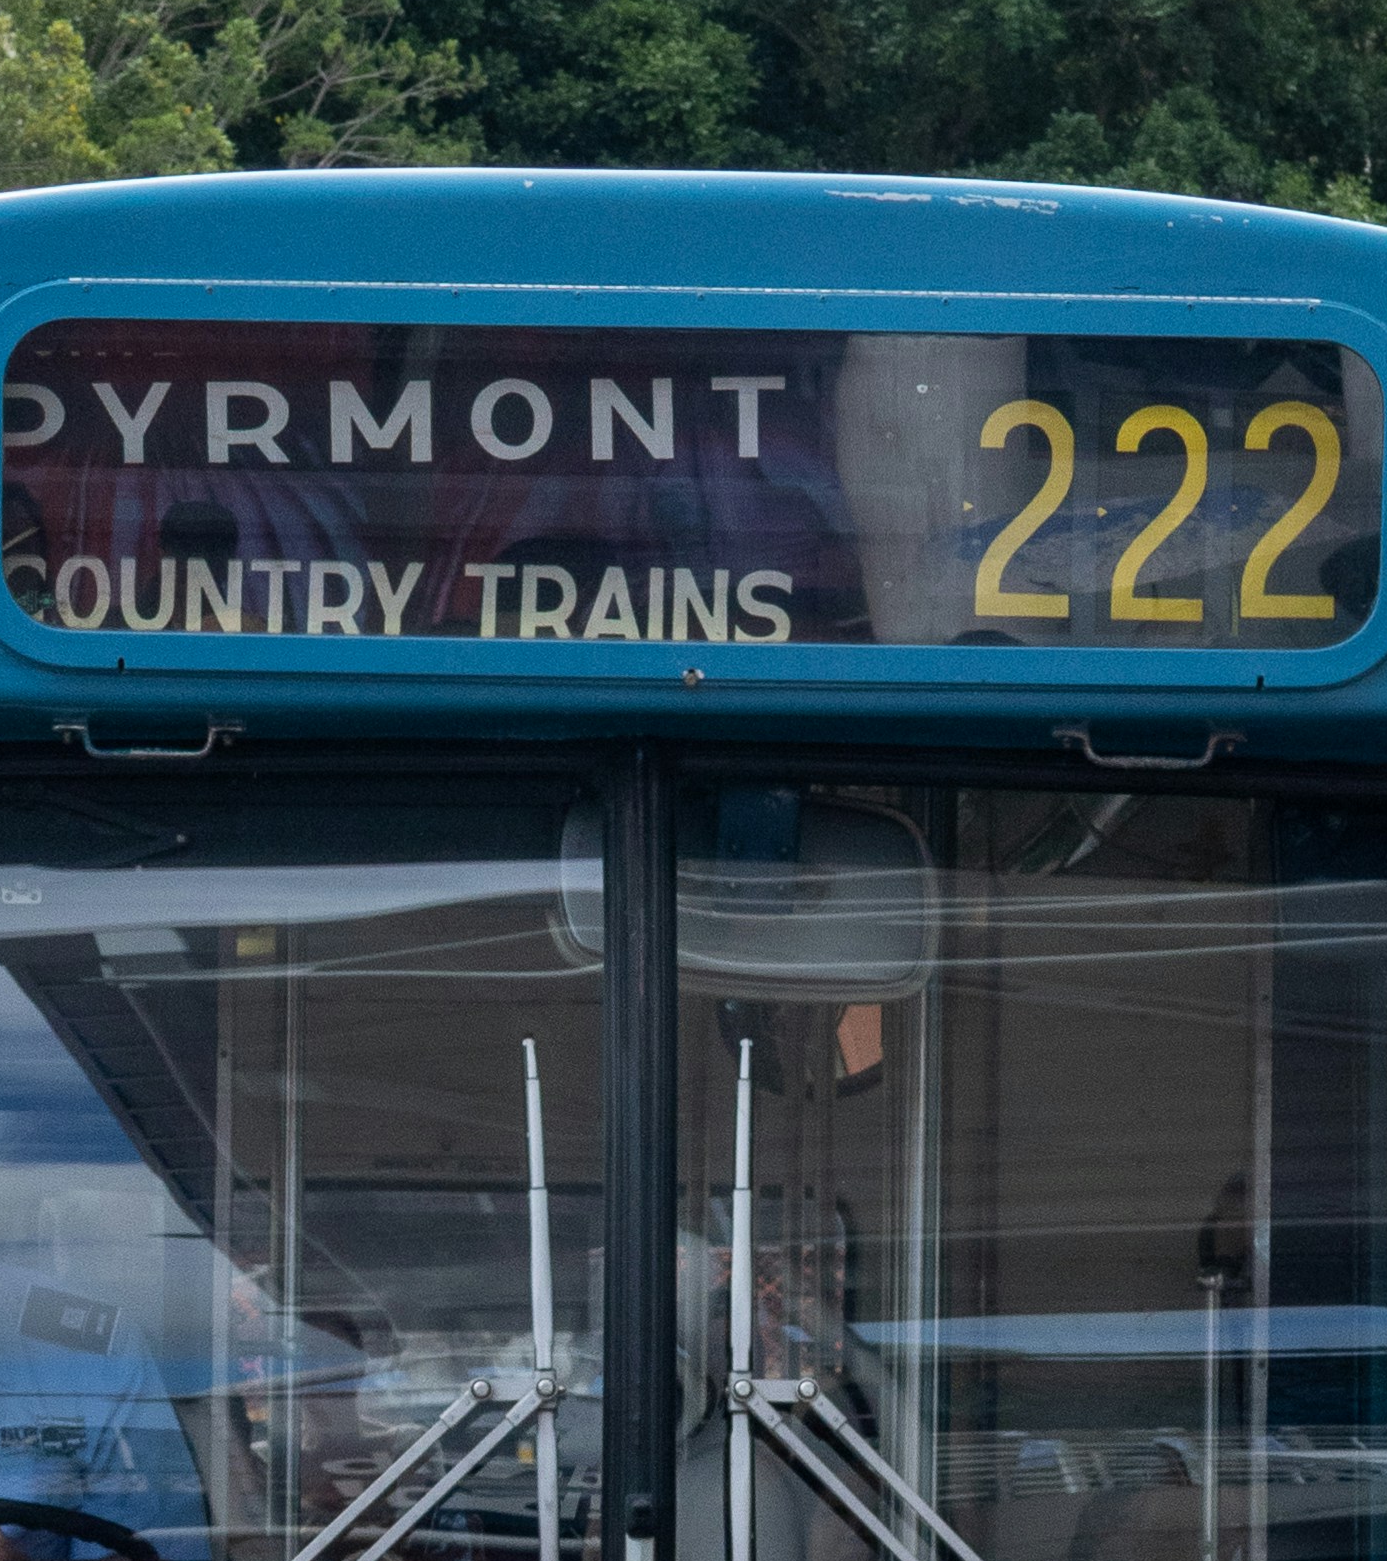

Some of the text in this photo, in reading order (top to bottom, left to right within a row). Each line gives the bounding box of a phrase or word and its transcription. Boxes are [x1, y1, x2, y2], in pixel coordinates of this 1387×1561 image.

[3, 375, 786, 464] PYRMONT
[975, 399, 1342, 622] 222
[3, 553, 794, 644] COUNTRY TRAINS
